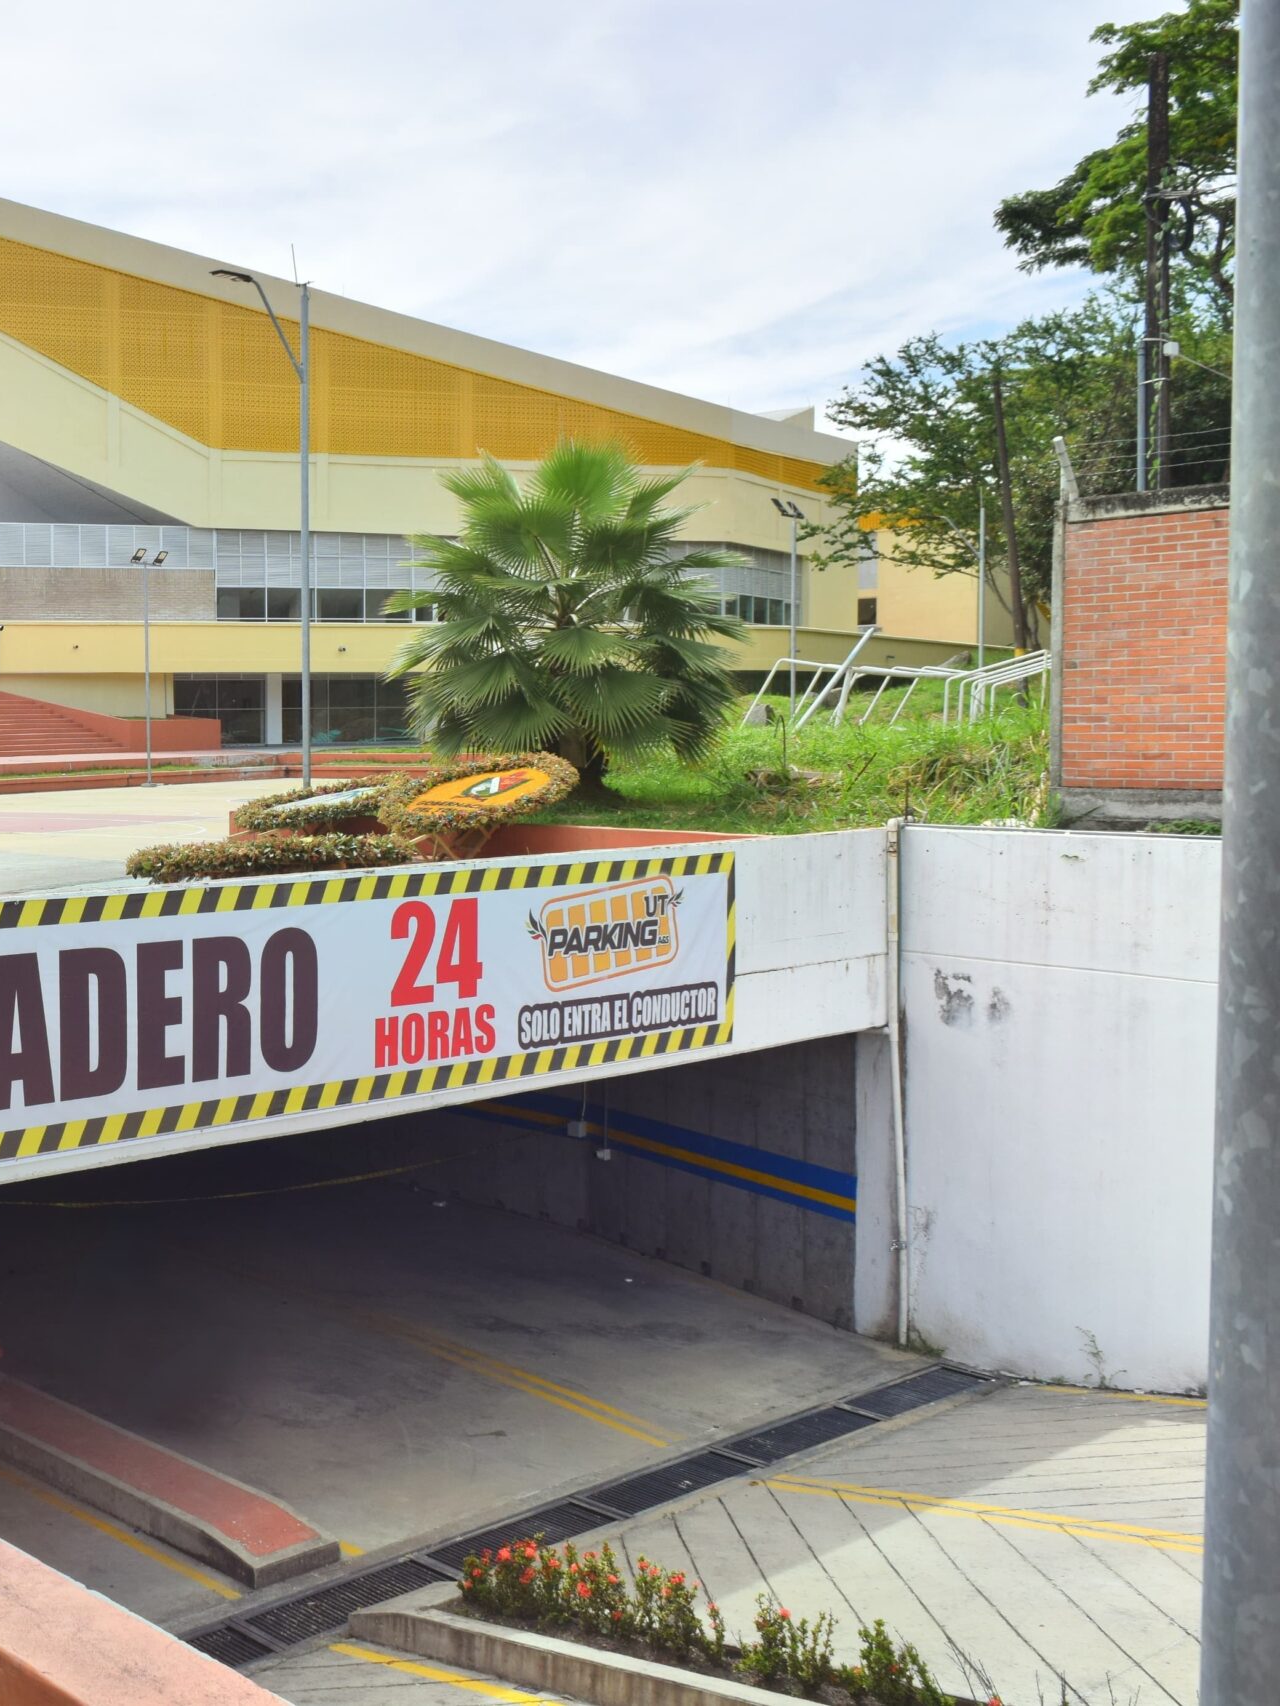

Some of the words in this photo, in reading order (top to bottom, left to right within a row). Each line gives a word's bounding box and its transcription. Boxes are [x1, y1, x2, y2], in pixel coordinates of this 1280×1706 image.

[644, 894, 669, 917] UT
[390, 898, 483, 1007] 24
[547, 919, 659, 957] PARKING
[374, 1003, 496, 1069] HORAS
[521, 1008, 561, 1043] SOLO
[564, 1001, 612, 1036] ENTRA
[614, 999, 629, 1030] EL
[632, 988, 716, 1028] CONDUCTOR
